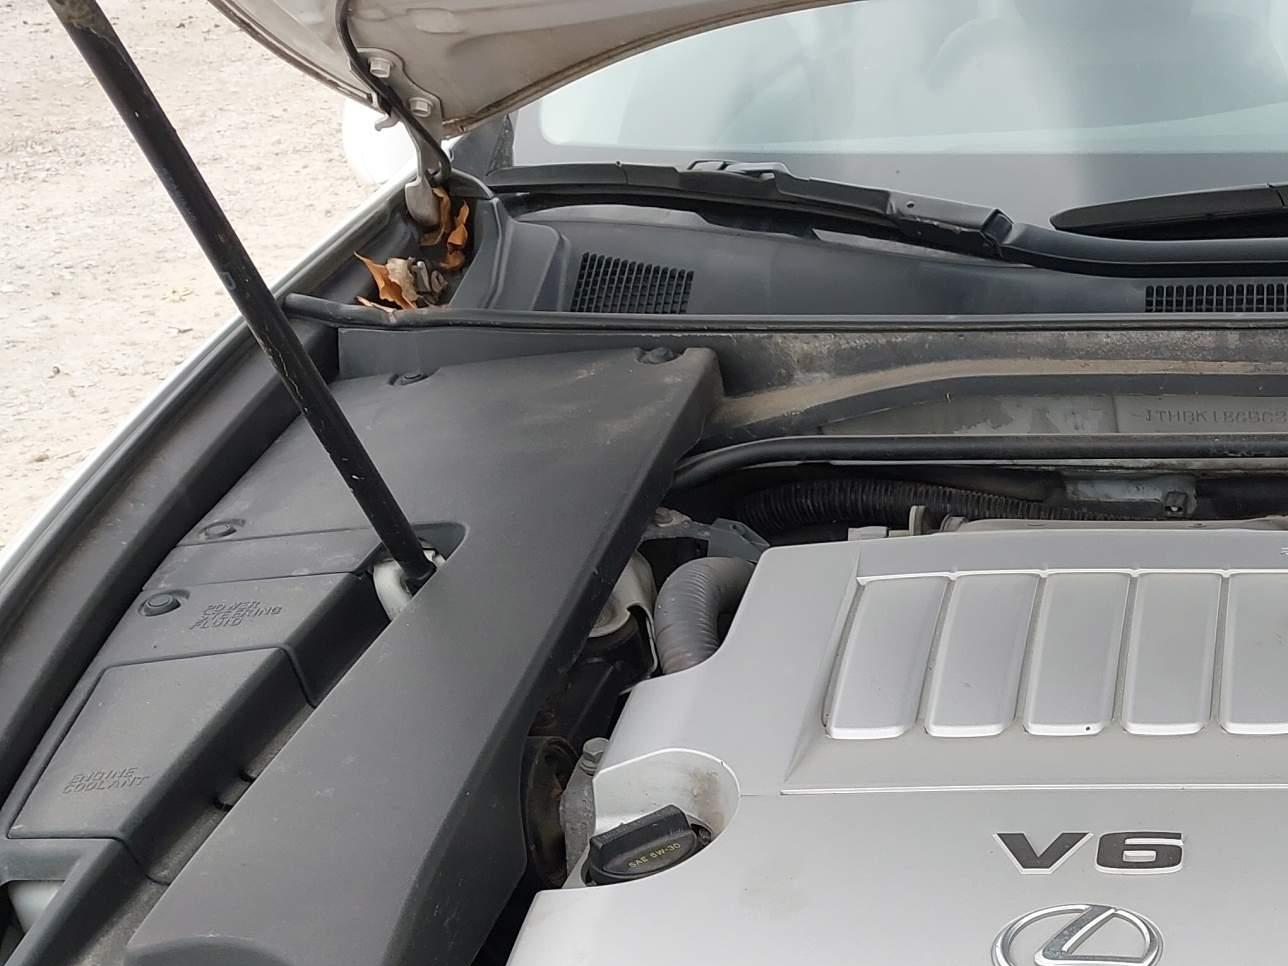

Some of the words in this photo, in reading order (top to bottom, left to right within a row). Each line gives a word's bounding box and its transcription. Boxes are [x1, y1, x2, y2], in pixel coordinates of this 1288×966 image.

[71, 767, 138, 783] ENGINE
[62, 775, 150, 793] COOLANT
[993, 831, 1184, 875] V6
[627, 855, 649, 869] SAE
